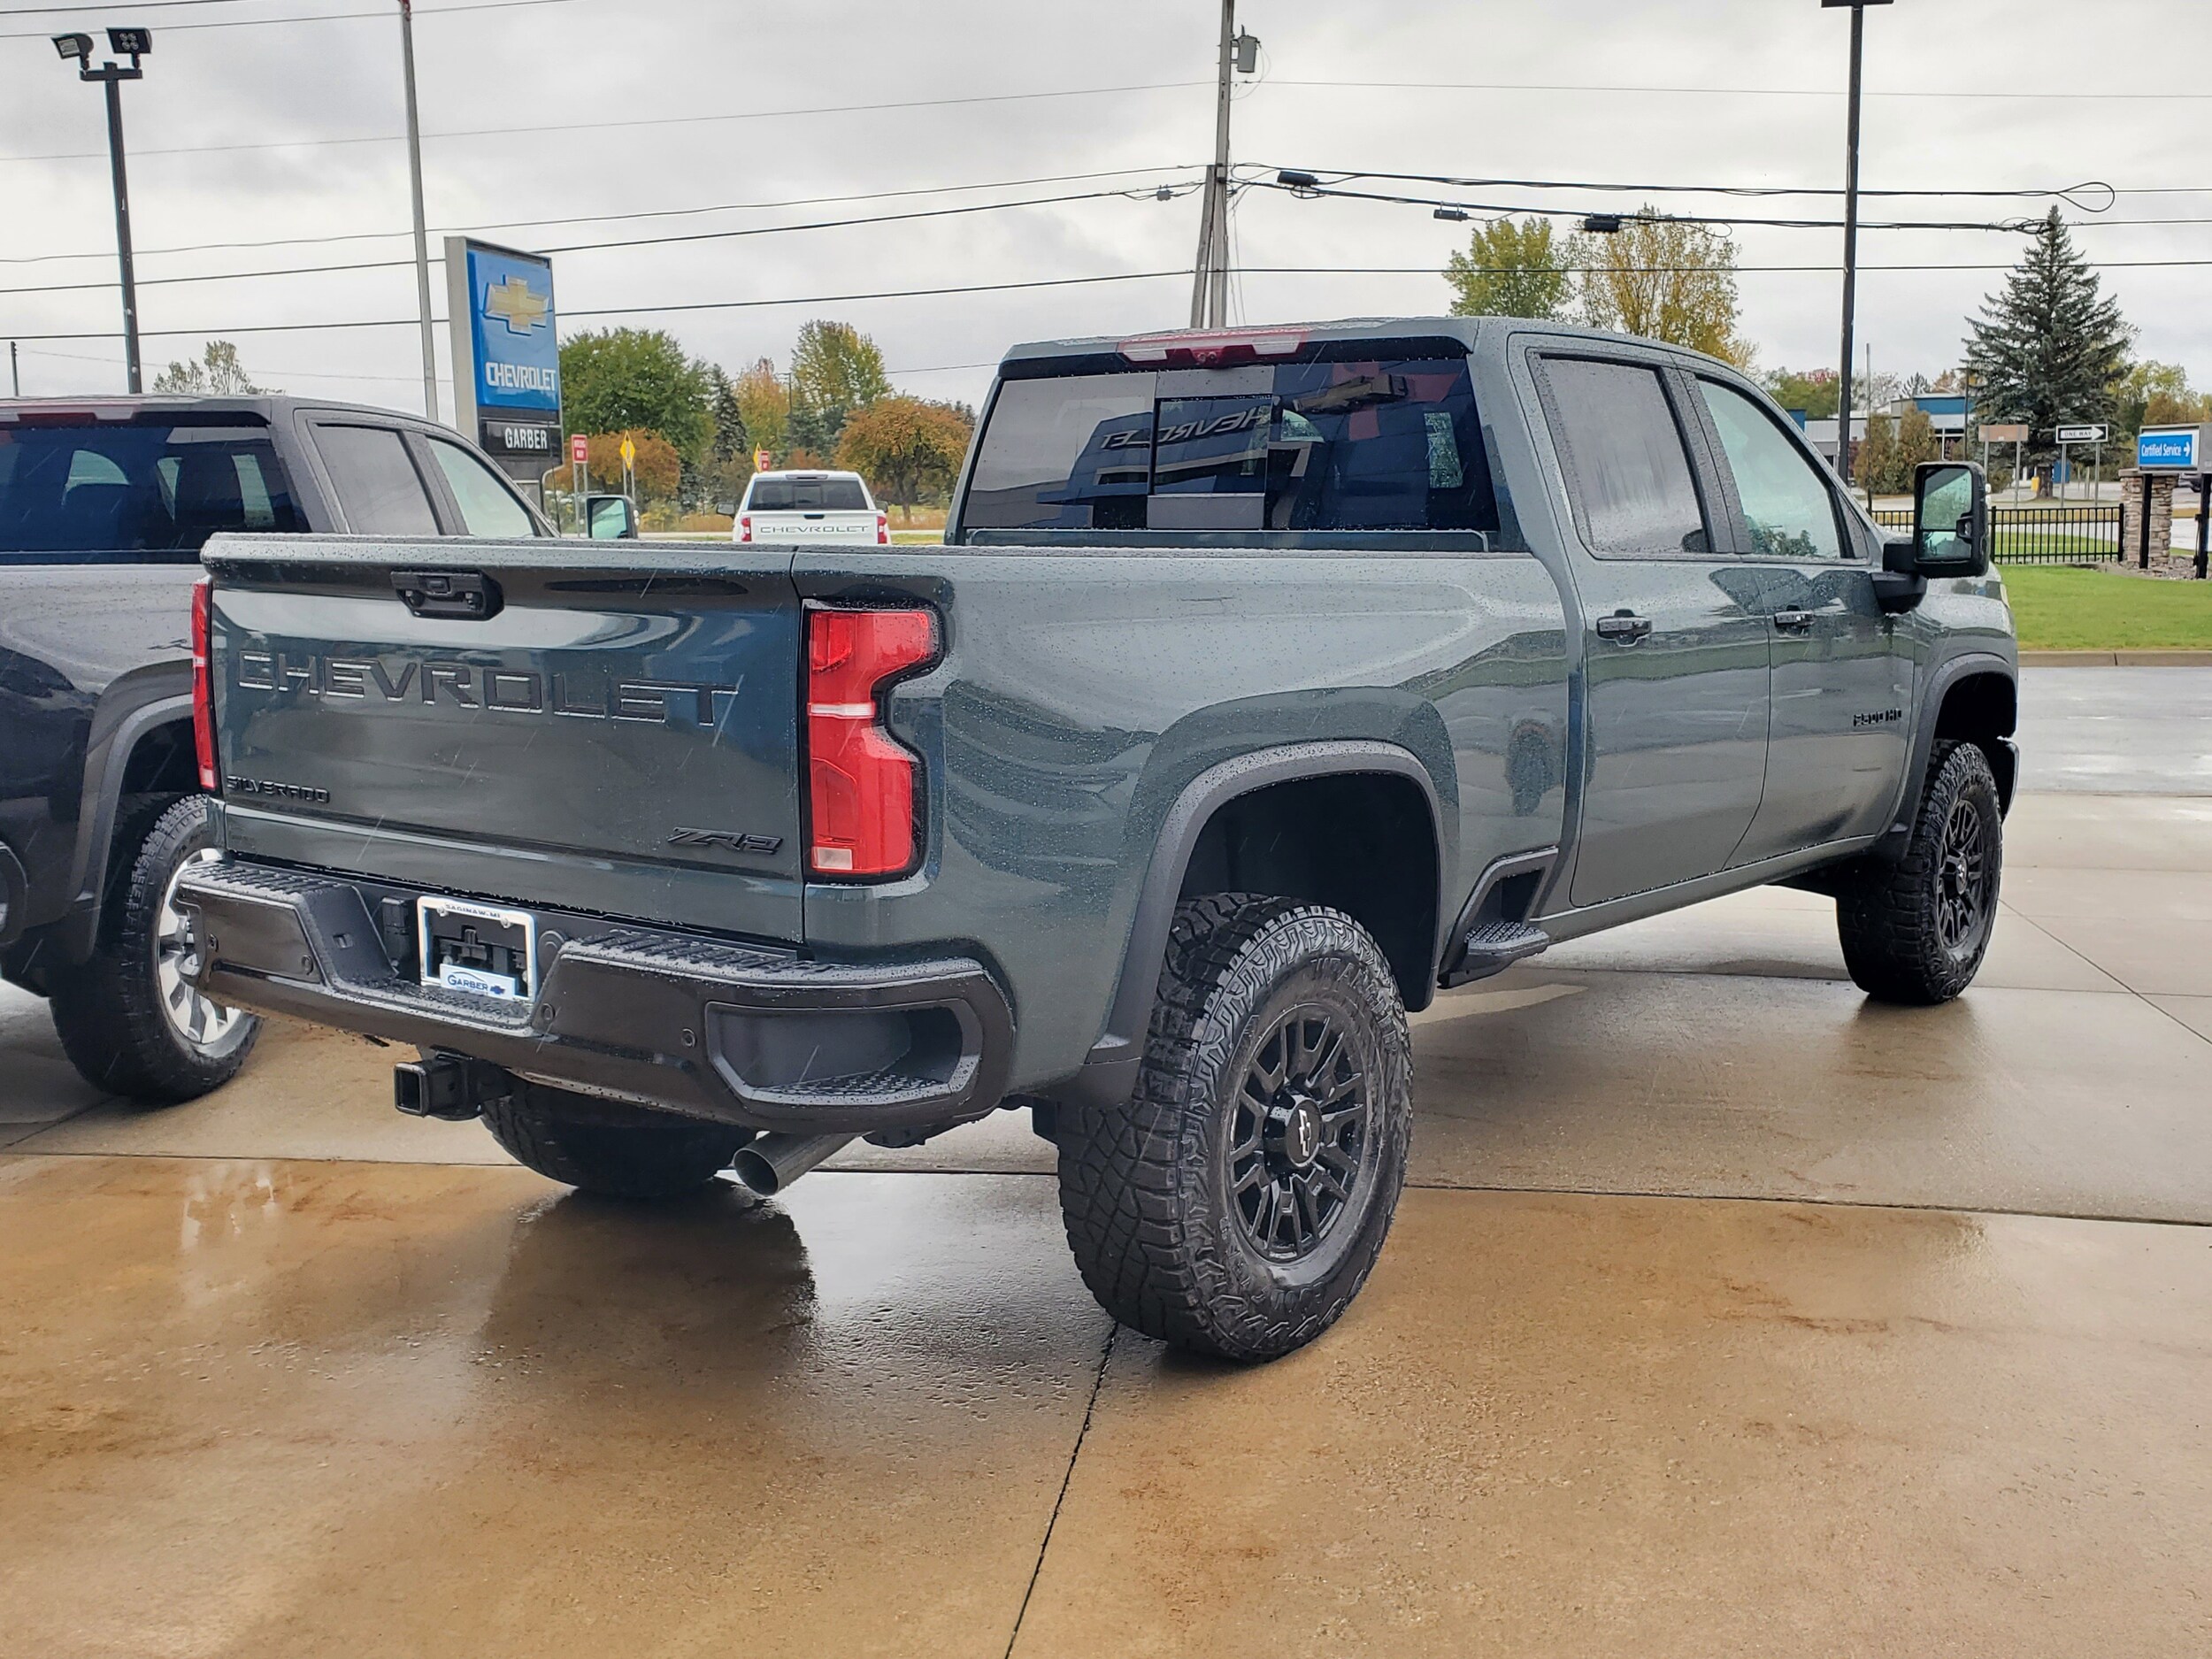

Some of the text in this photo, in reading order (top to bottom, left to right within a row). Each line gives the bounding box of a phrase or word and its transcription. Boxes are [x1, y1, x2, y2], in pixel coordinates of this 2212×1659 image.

[486, 362, 556, 391] CHEVROLET
[504, 426, 548, 449] GARBER
[2141, 442, 2182, 457] Certified Service
[760, 526, 870, 534] CHEVROLET
[238, 649, 739, 727] CHEVROLET
[227, 775, 330, 803] SILVERADO
[667, 826, 784, 856] ZR2
[447, 974, 488, 991] GARBER
